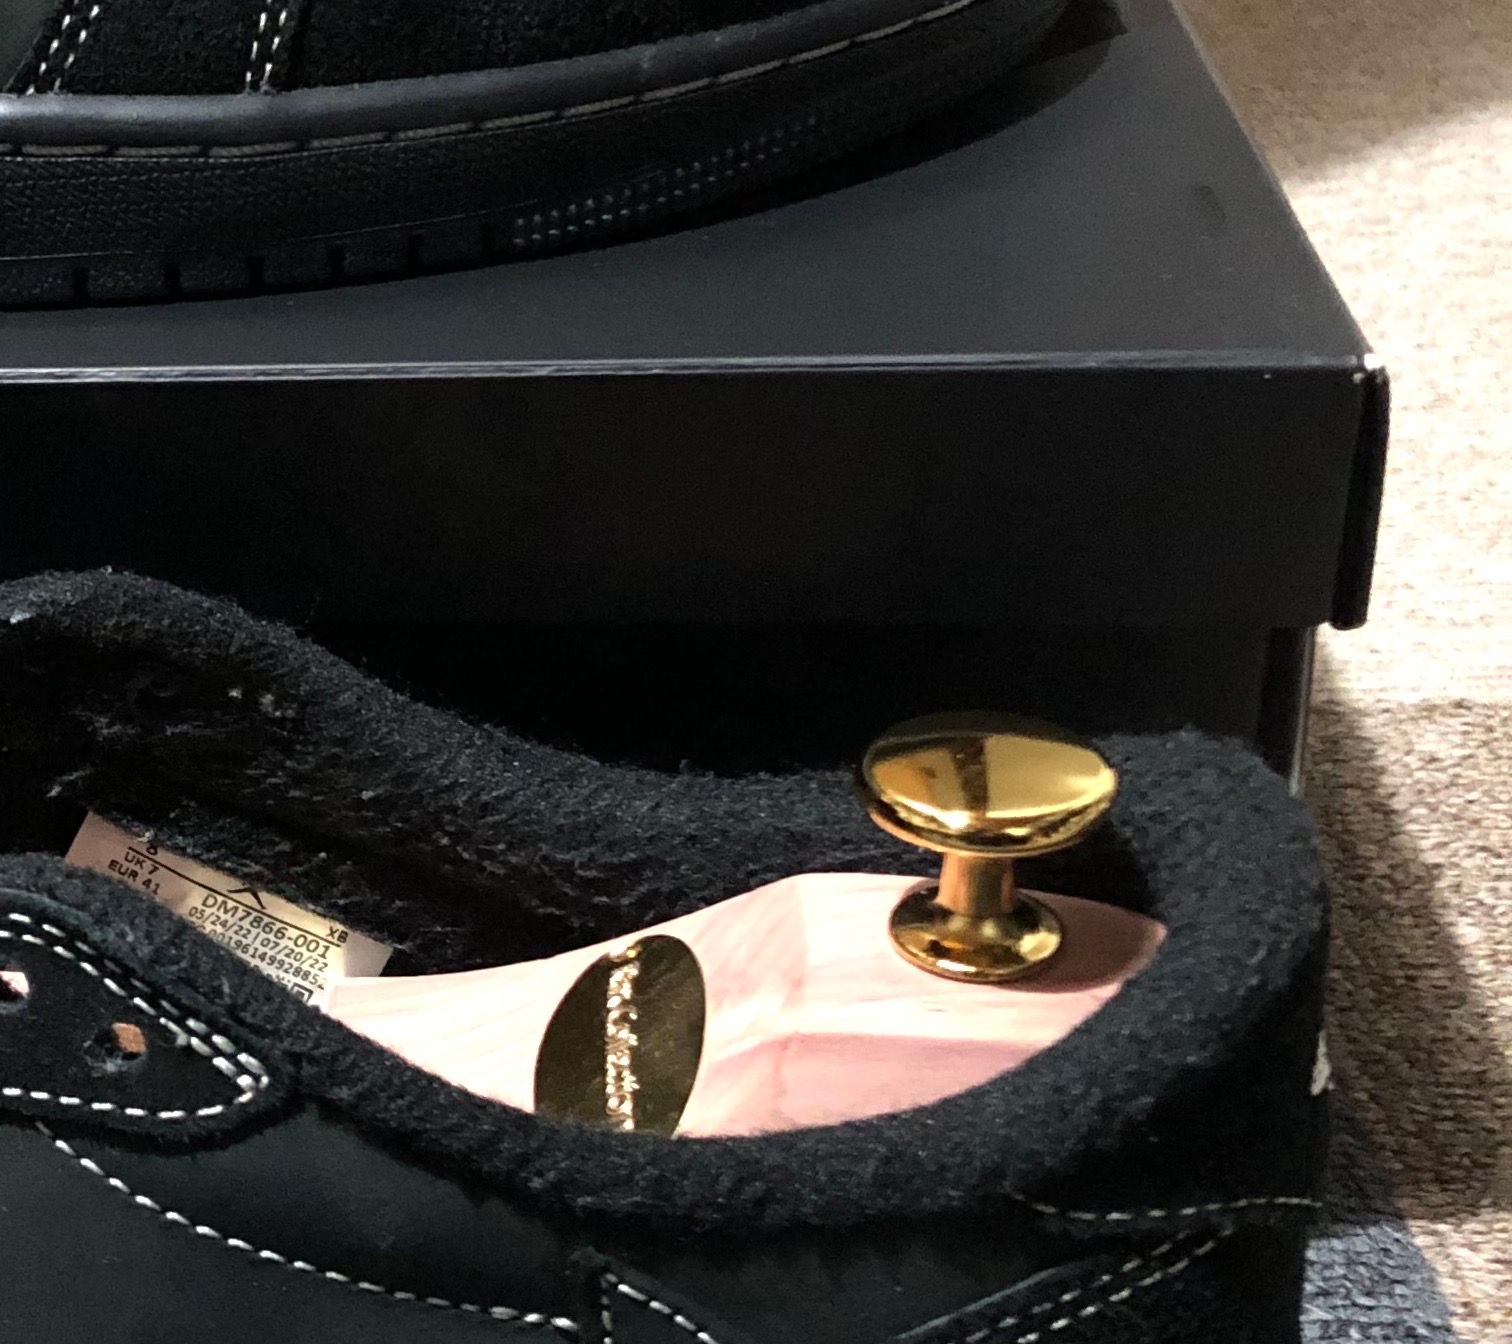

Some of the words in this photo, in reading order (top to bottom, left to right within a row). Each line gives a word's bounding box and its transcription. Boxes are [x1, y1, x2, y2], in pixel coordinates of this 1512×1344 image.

[107, 859, 139, 883] EUR
[141, 877, 161, 896] 41
[123, 851, 147, 870] UK
[147, 864, 160, 876] 7
[188, 906, 252, 941] 05/24/22
[259, 936, 328, 975] 07/20/22
[201, 893, 332, 960] DM7866-001
[326, 925, 348, 944] XB
